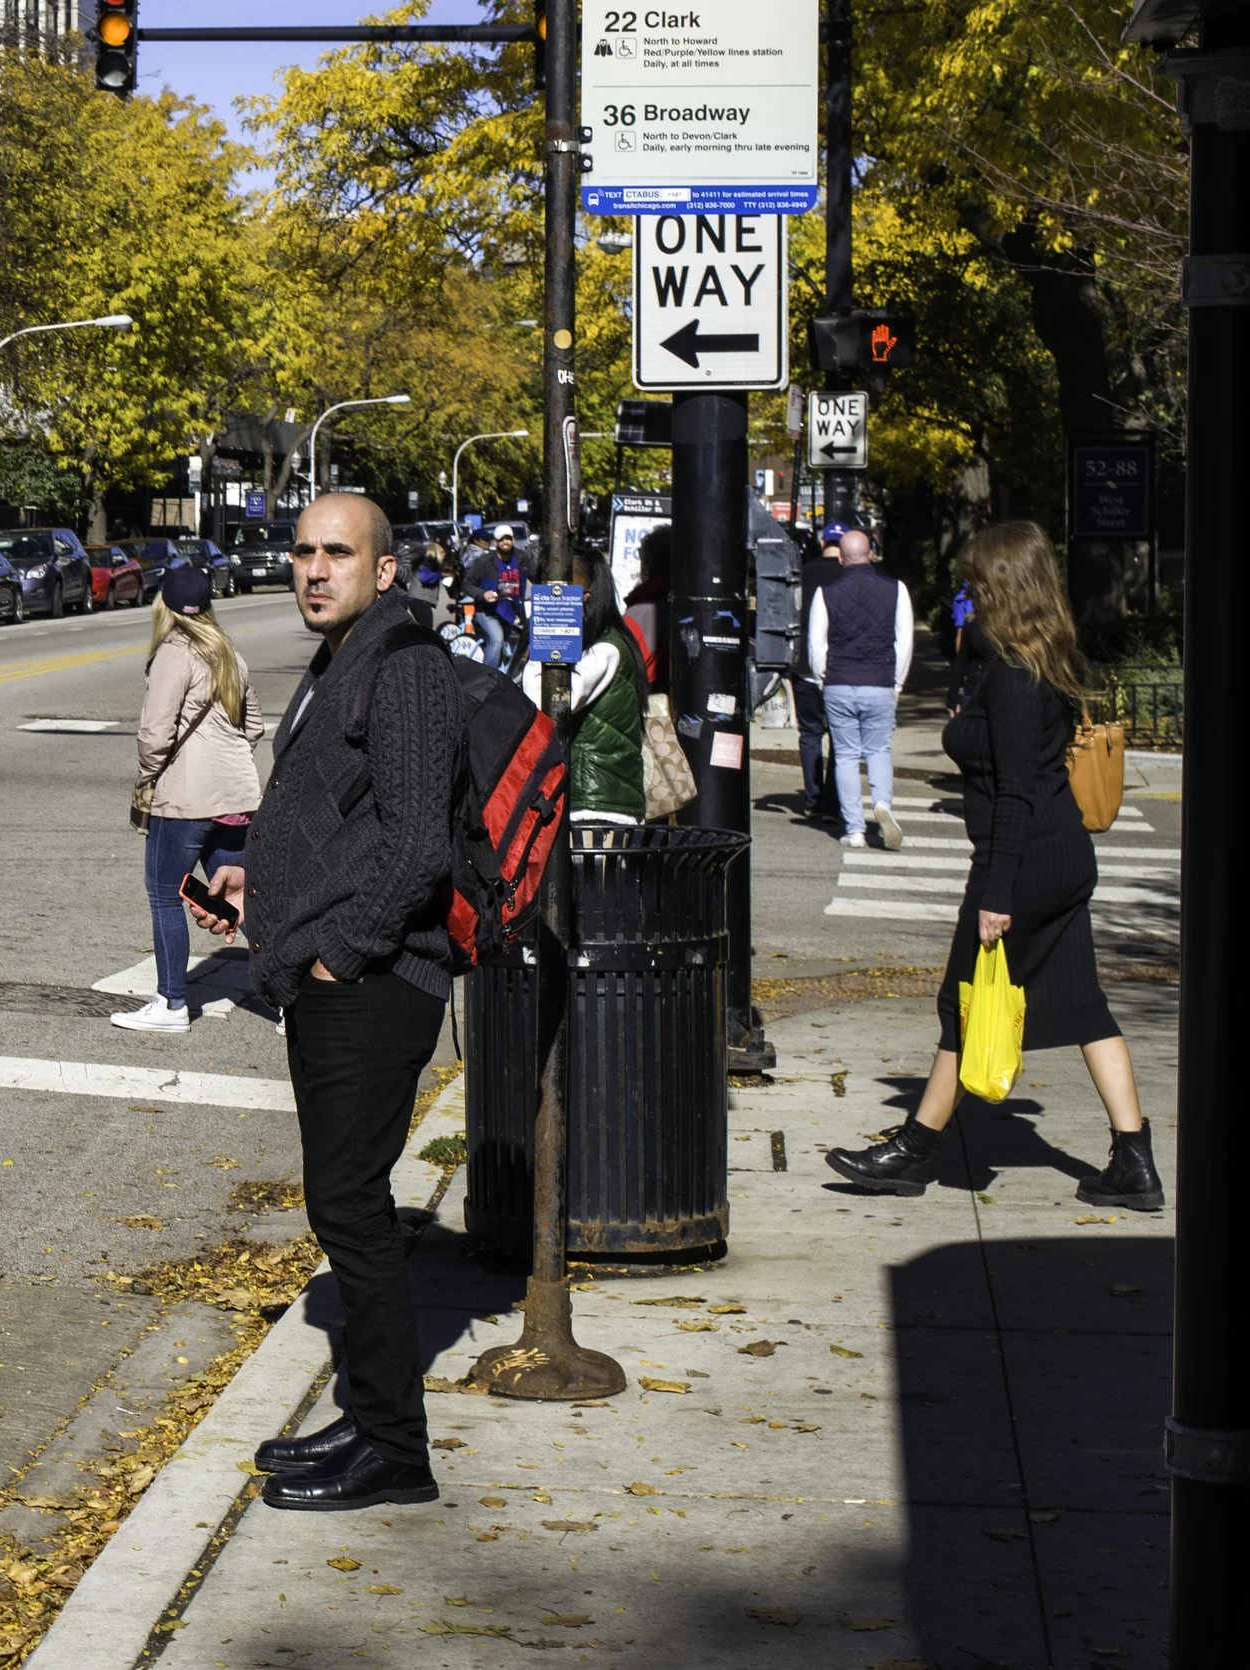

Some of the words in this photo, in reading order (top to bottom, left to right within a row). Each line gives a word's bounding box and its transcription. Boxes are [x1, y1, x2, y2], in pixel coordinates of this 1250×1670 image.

[604, 11, 637, 33] 22
[643, 10, 701, 28] Clark
[643, 38, 668, 46] North
[682, 38, 718, 46] Howard
[643, 48, 726, 58] Red/Purple/Yellow
[728, 48, 750, 56] lines
[752, 48, 783, 56] station
[643, 60, 668, 68] Daily,
[681, 60, 692, 68] all
[695, 60, 720, 68] times
[603, 104, 636, 126] 36
[643, 104, 751, 125] Broadway
[642, 132, 668, 140] North
[682, 132, 738, 140] Devon/Clark
[642, 144, 668, 152] Daily,
[670, 144, 692, 152] early
[694, 144, 732, 152] morning
[734, 144, 753, 152] thru
[755, 143, 772, 152] late
[774, 143, 810, 152] evening
[626, 190, 660, 198] CTABUS
[686, 202, 704, 210] (312)
[655, 214, 763, 254] ONE
[651, 263, 766, 308] WAY
[817, 400, 860, 416] ONE
[816, 420, 861, 437] WAY
[1086, 460, 1138, 477] 52-88
[1098, 494, 1124, 504] West
[1091, 506, 1132, 516] Schiller
[1096, 518, 1126, 528] Street
